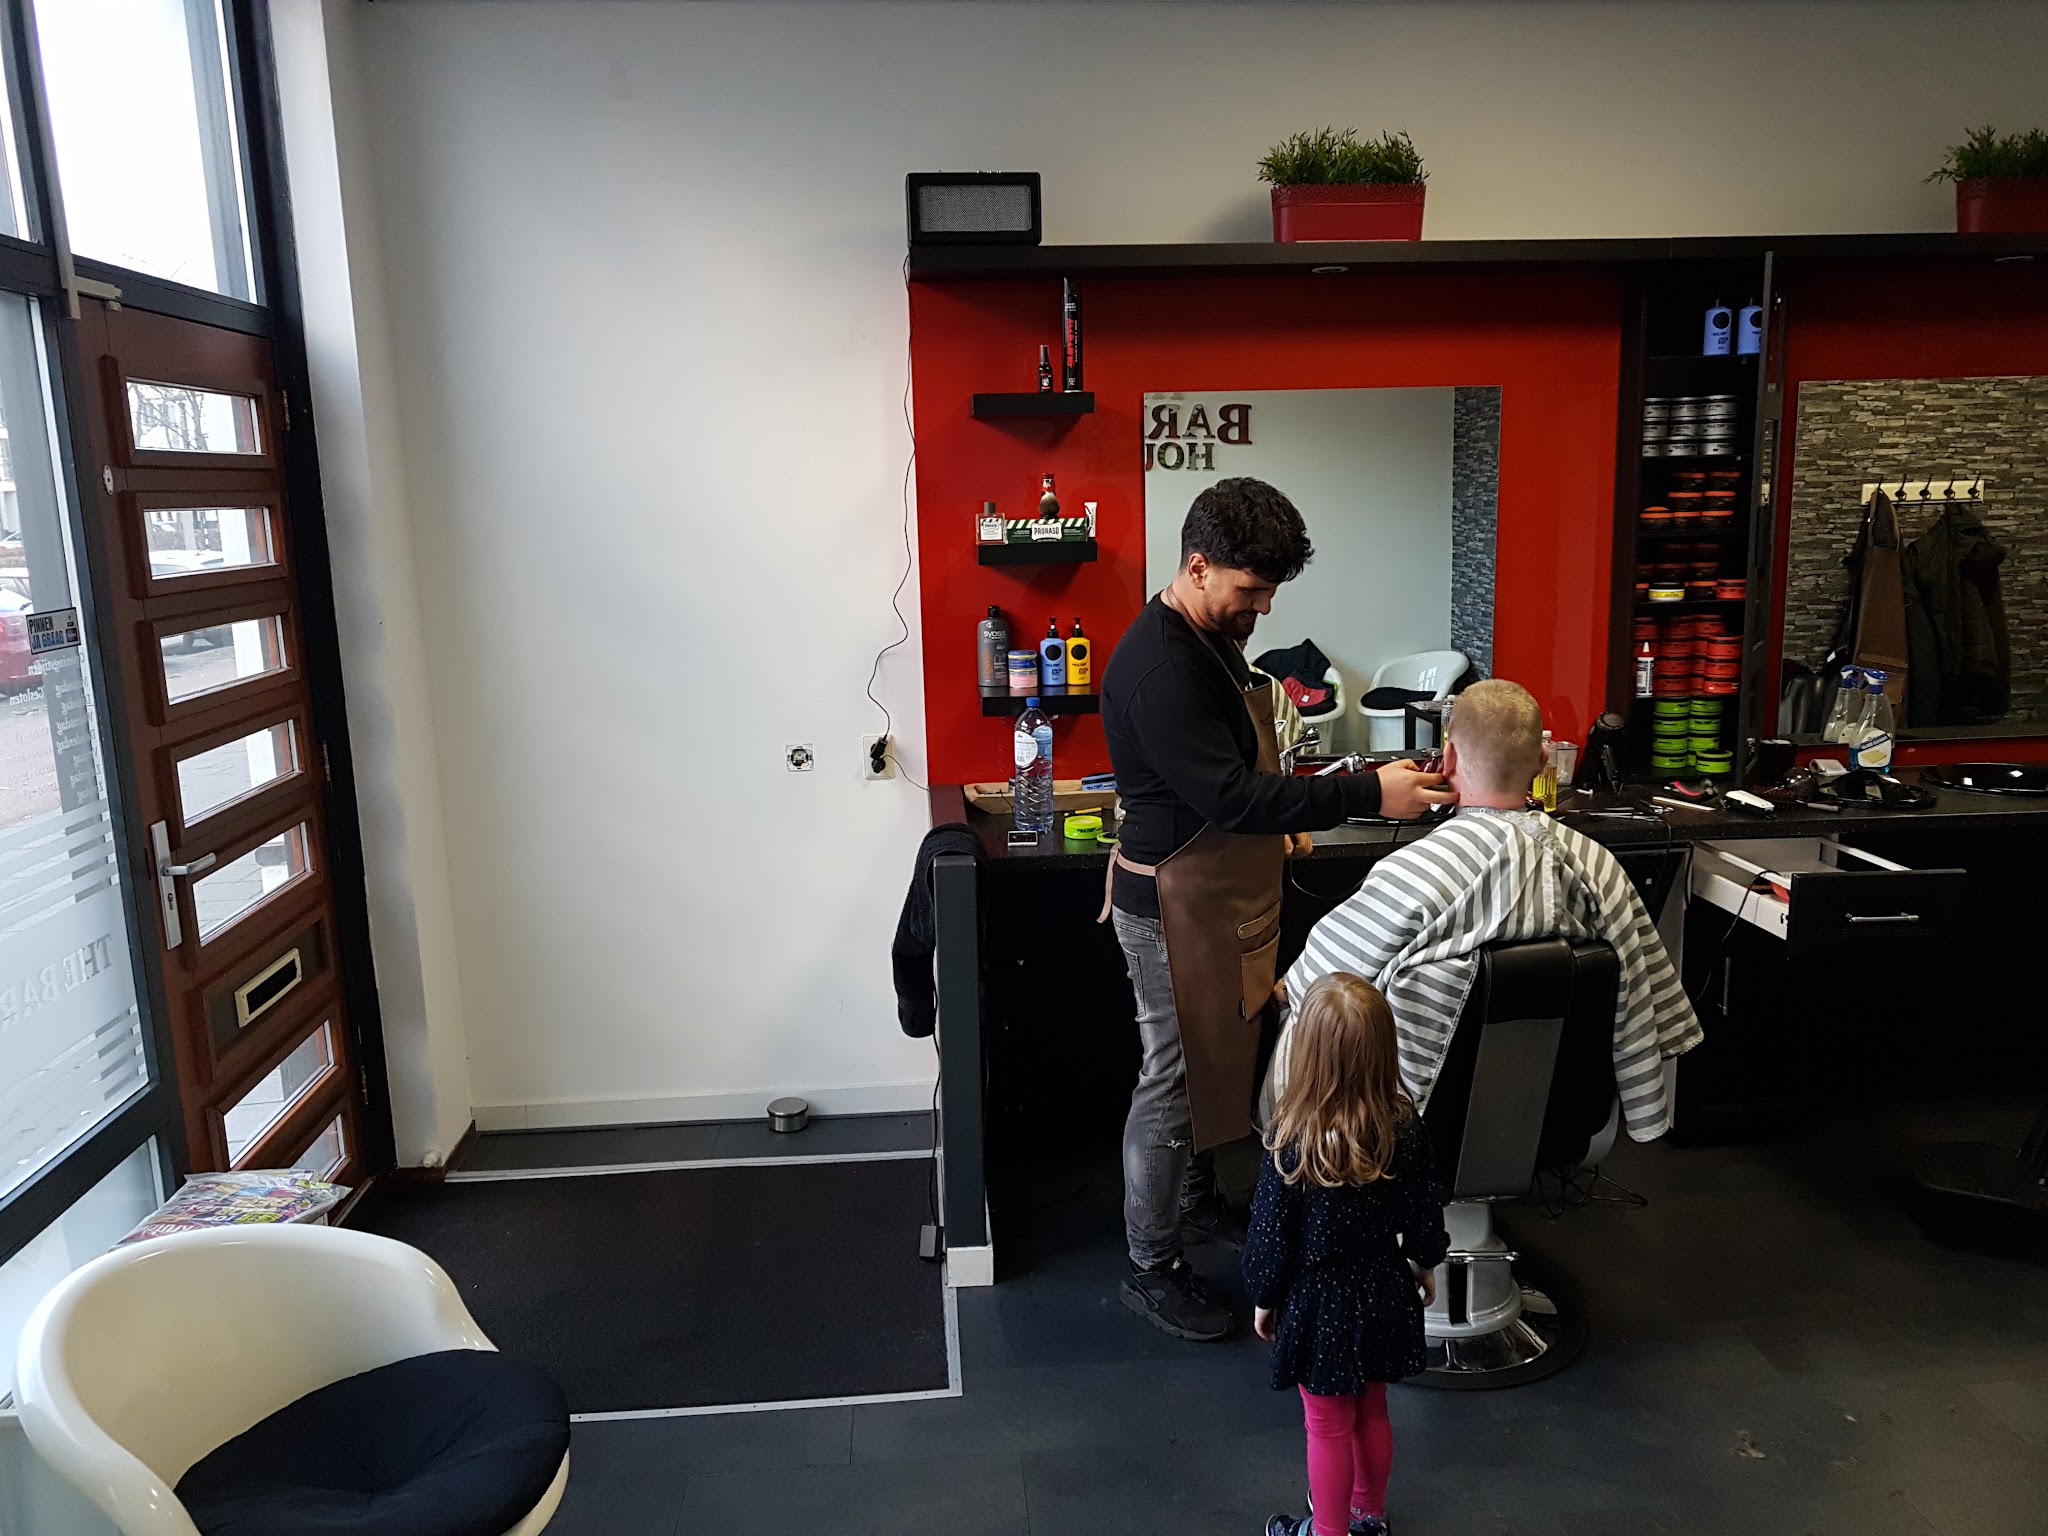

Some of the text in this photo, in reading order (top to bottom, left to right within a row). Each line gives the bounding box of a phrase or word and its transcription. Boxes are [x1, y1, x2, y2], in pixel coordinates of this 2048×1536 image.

[1033, 526, 1060, 536] PRORASO
[28, 616, 54, 634] PINNEN
[32, 630, 65, 650] JA GRAAG
[983, 630, 1006, 639] syoss
